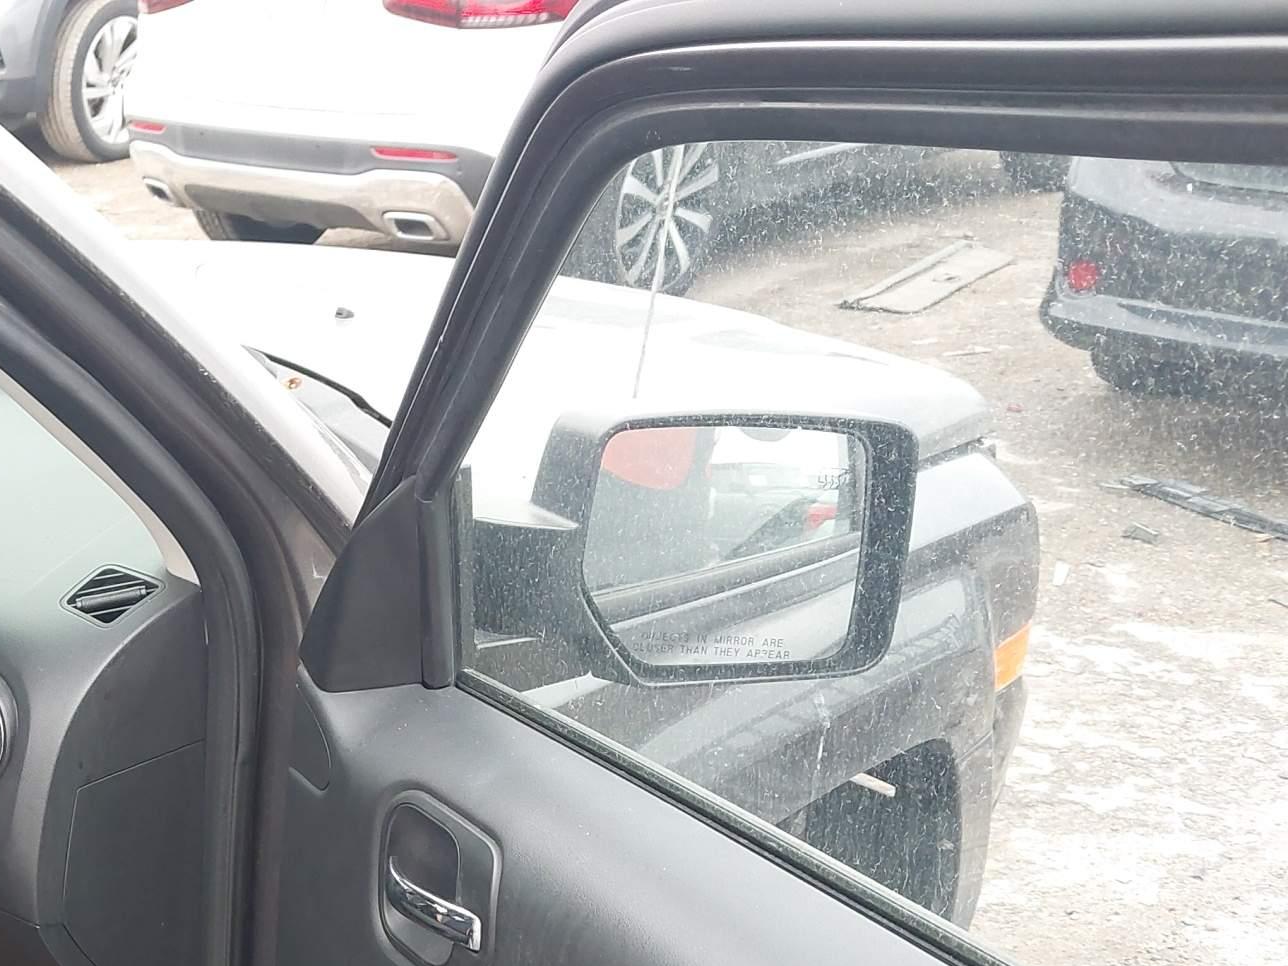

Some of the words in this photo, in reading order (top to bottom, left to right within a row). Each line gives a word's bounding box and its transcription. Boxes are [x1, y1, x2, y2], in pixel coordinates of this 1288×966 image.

[696, 632, 708, 645] IN
[714, 633, 755, 647] MIRROR
[762, 637, 785, 648] ARE
[679, 644, 708, 656] THAN
[713, 645, 741, 657] THEY
[746, 648, 791, 660] APPEAR
